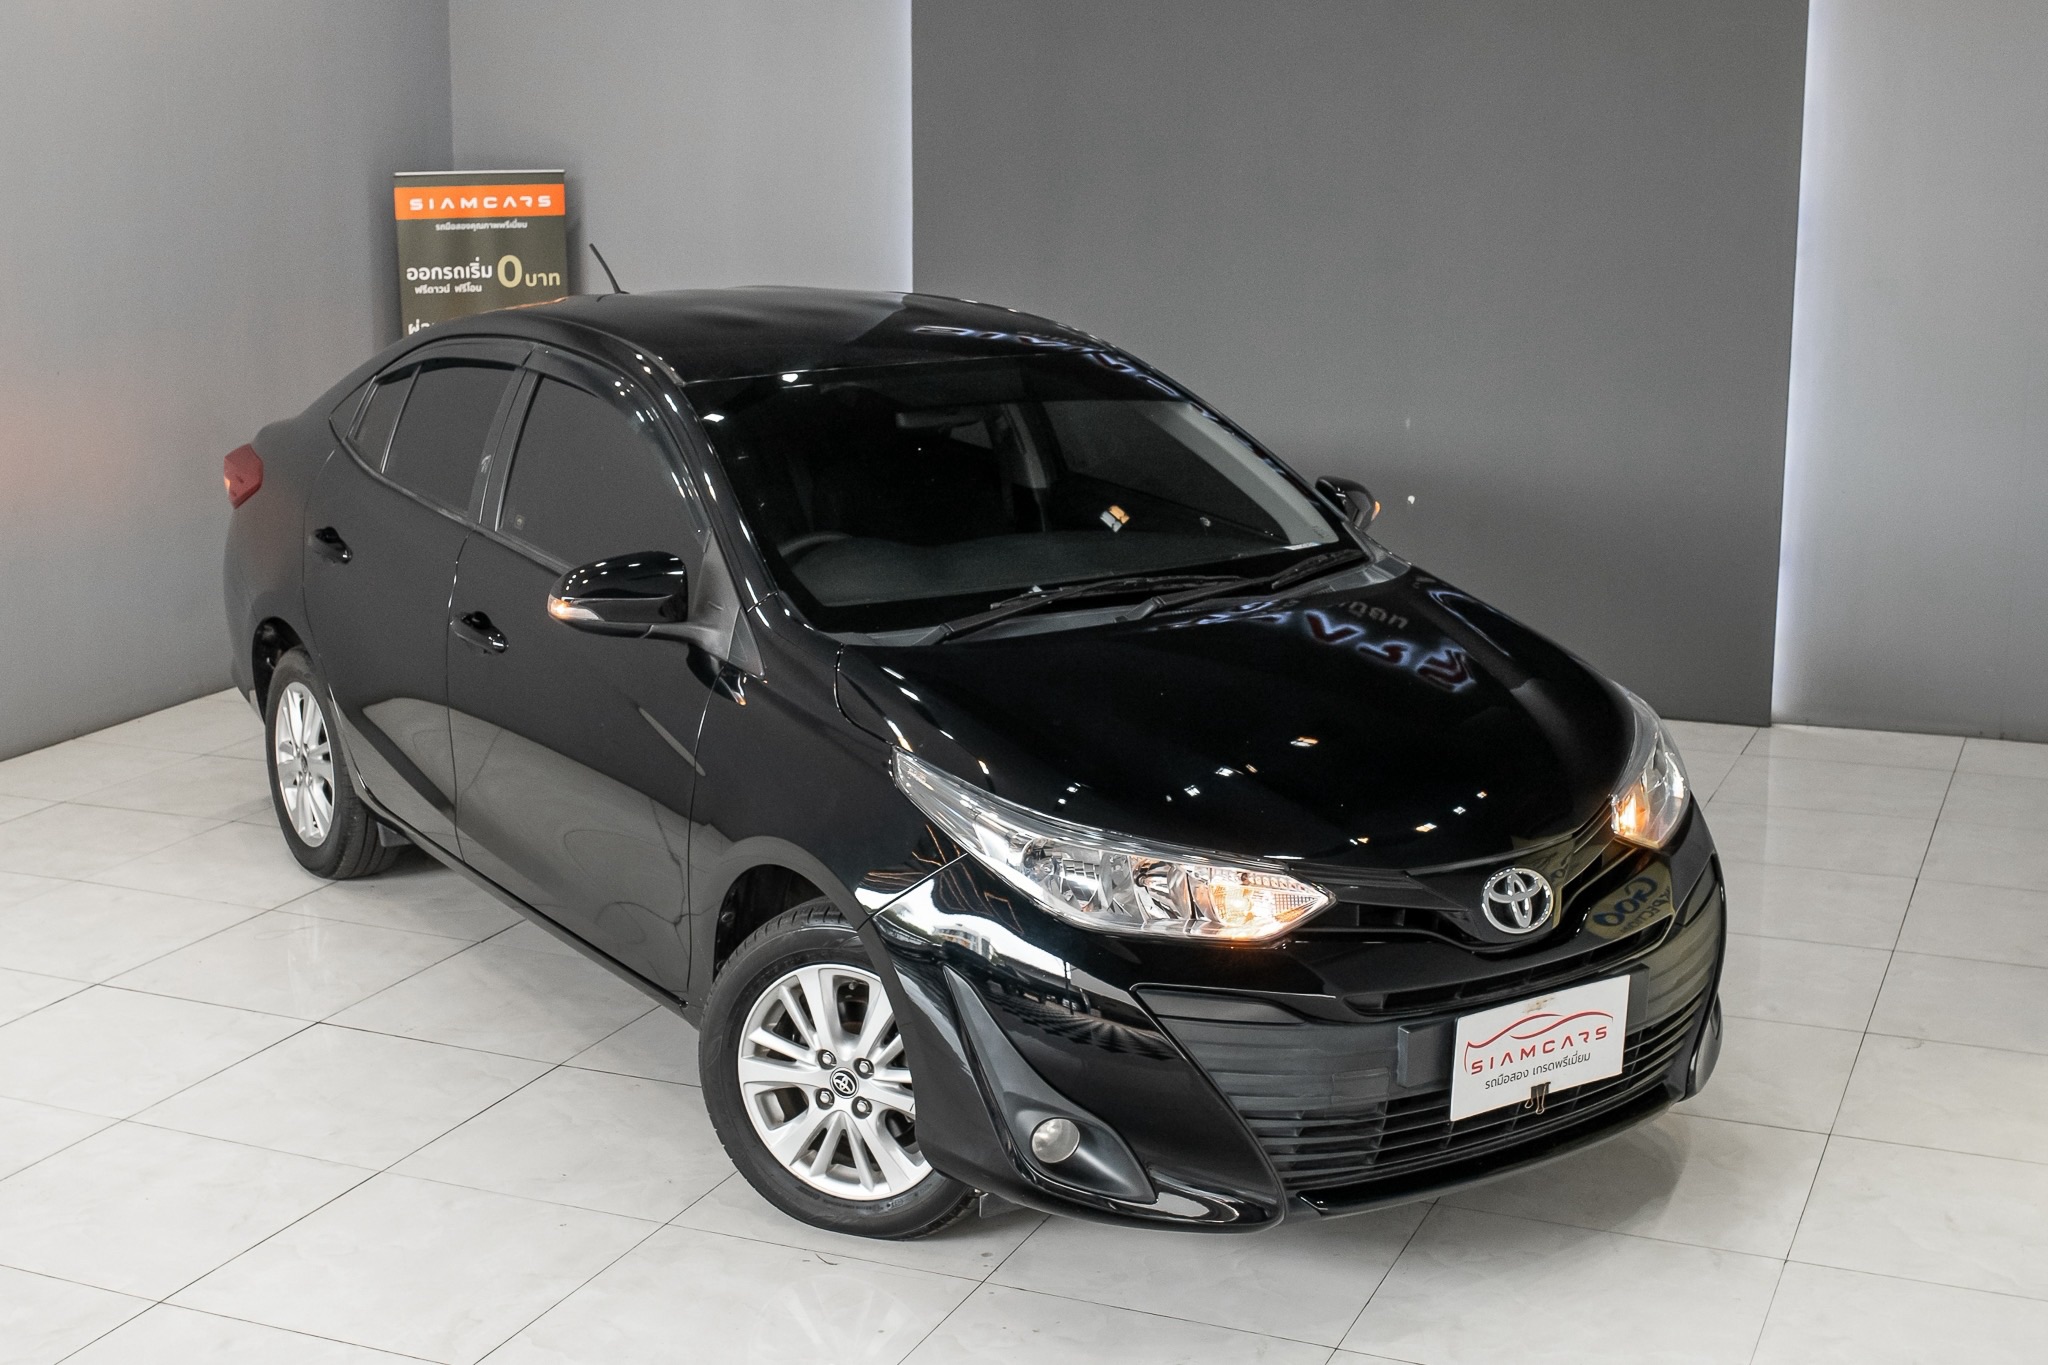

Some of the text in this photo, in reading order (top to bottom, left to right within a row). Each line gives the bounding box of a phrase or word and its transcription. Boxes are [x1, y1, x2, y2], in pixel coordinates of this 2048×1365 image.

[409, 195, 552, 211] SIAMCARS
[406, 254, 561, 288] ออกรถเริ่ม 0 บาท
[1470, 1025, 1608, 1076] SIAMCARS
[1484, 1051, 1591, 1090] รถมือสอง เกรดพรีเมี่ยม
